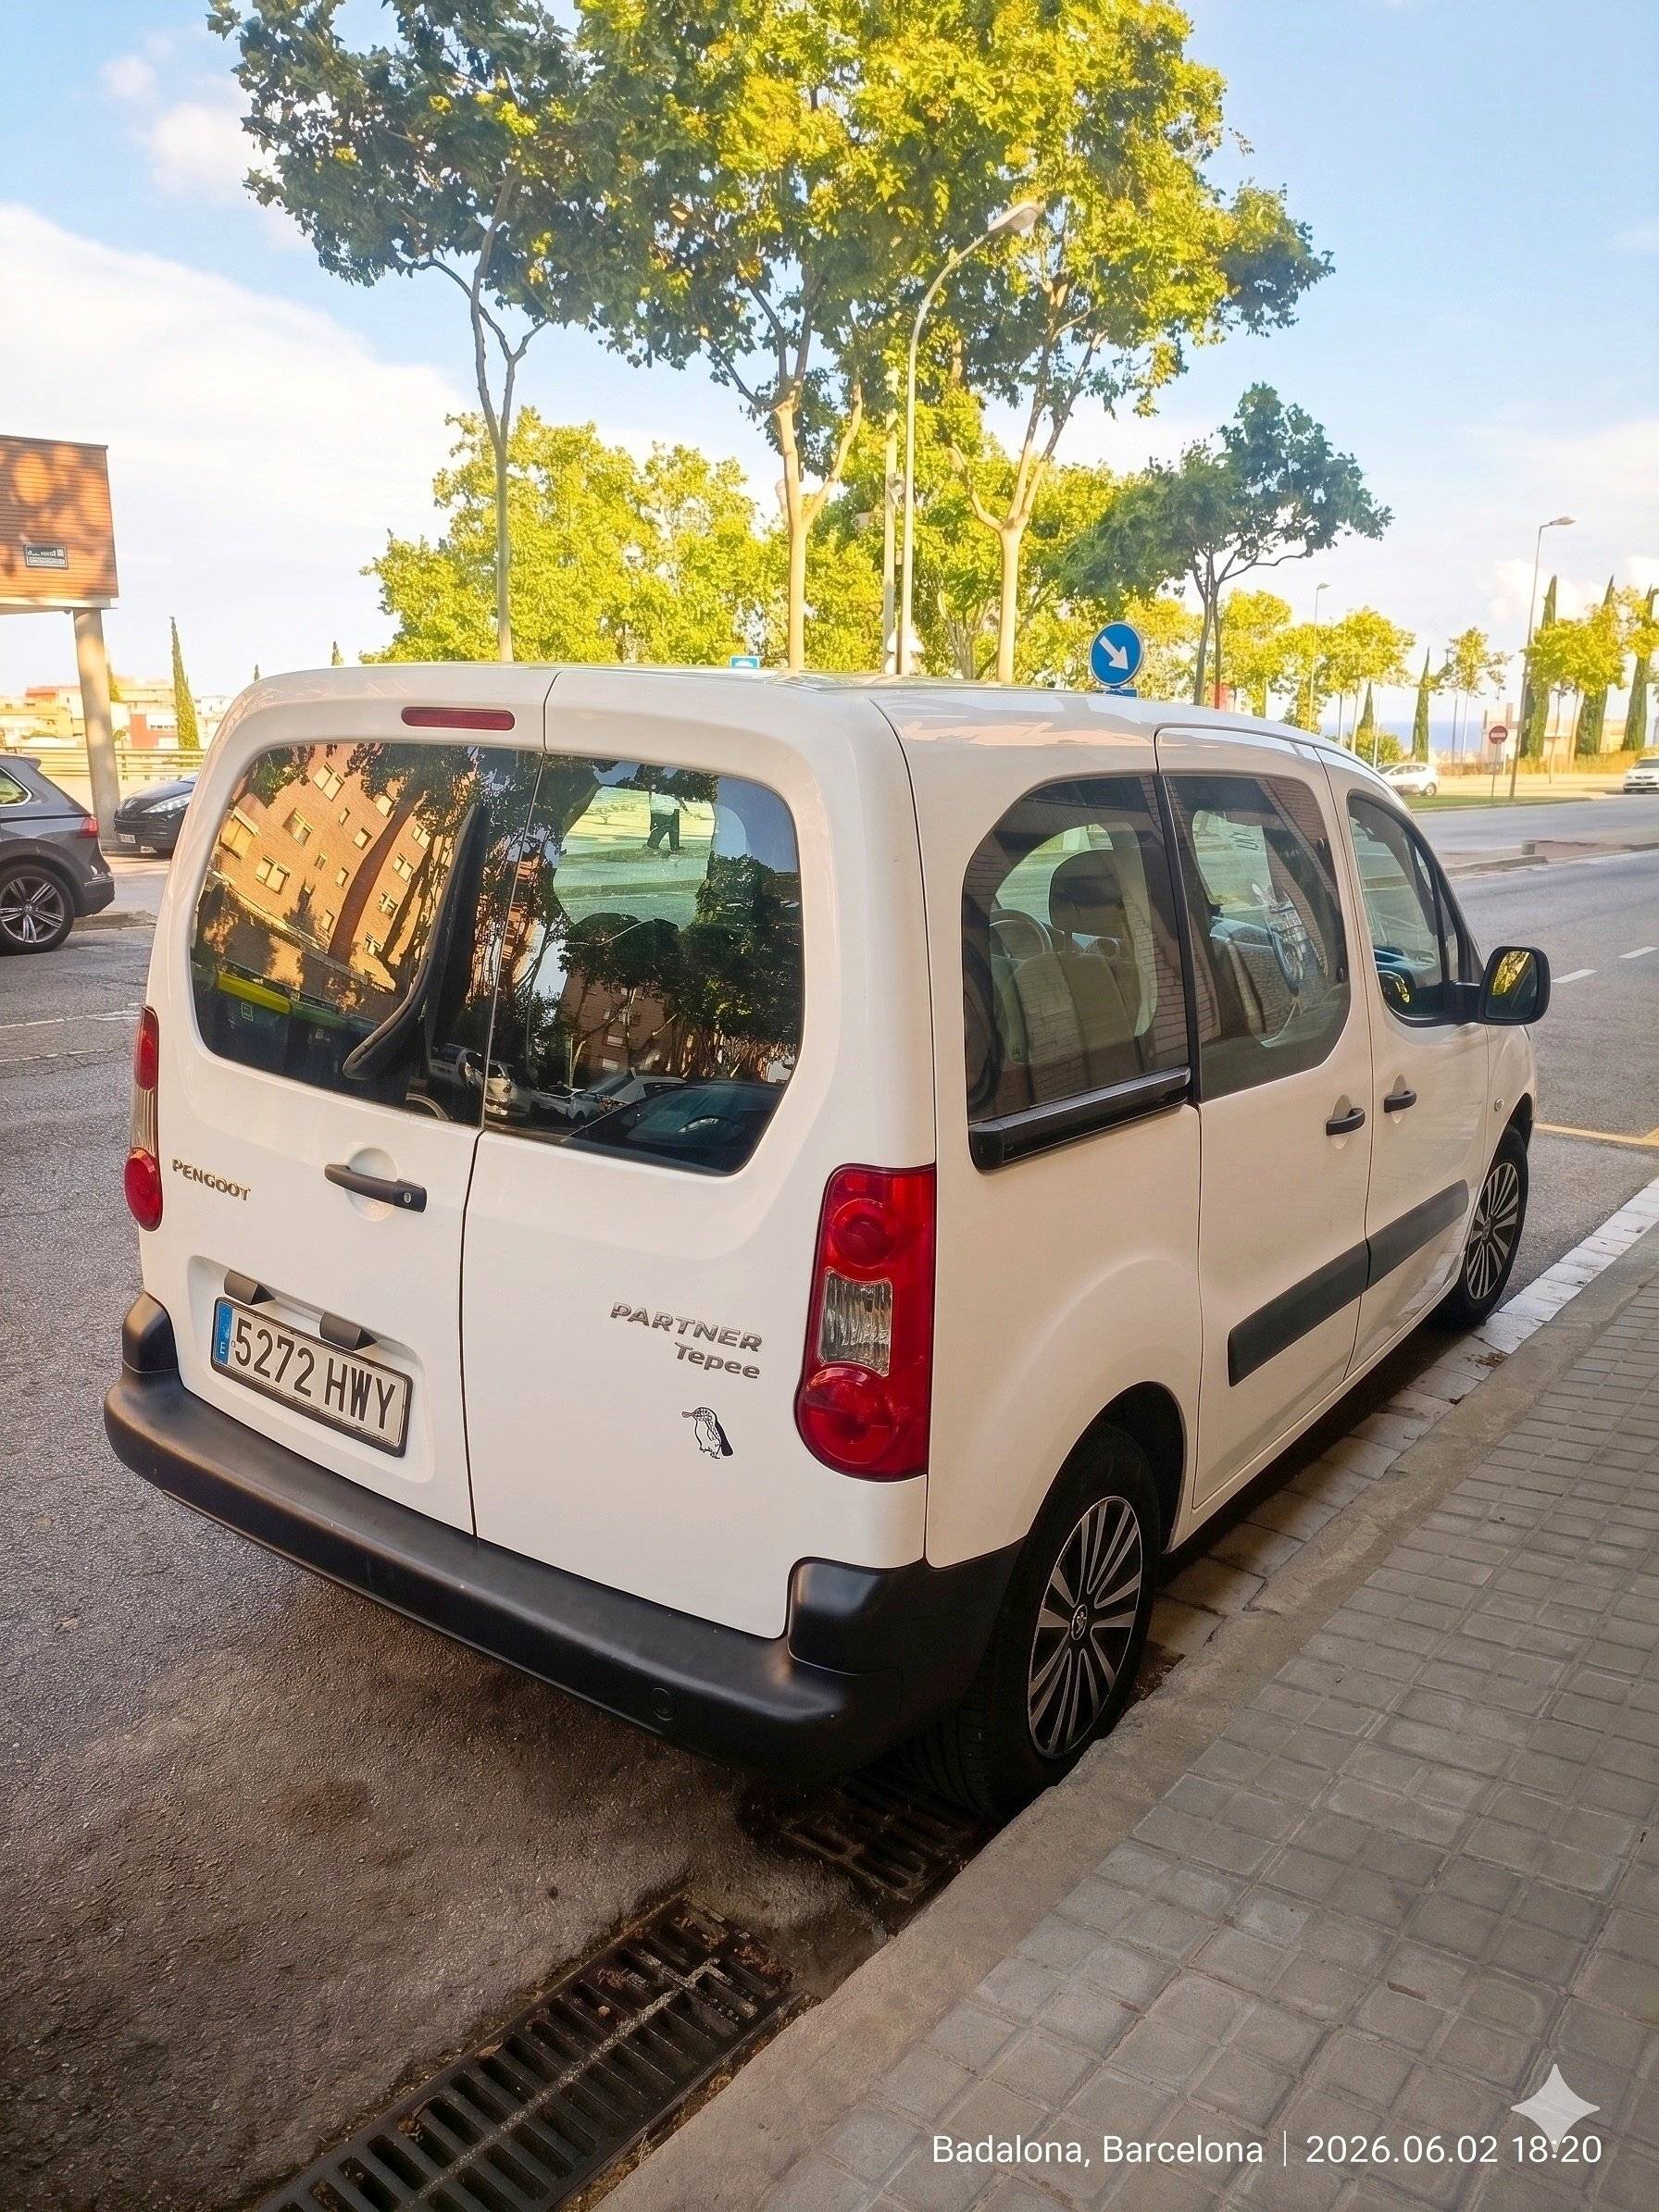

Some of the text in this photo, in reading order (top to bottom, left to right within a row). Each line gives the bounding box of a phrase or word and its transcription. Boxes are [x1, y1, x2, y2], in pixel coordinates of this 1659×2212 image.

[610, 1301, 763, 1352] PARTNER
[219, 1343, 226, 1355] E
[674, 1341, 761, 1379] Tepee
[234, 1317, 396, 1430] 5272 HWY
